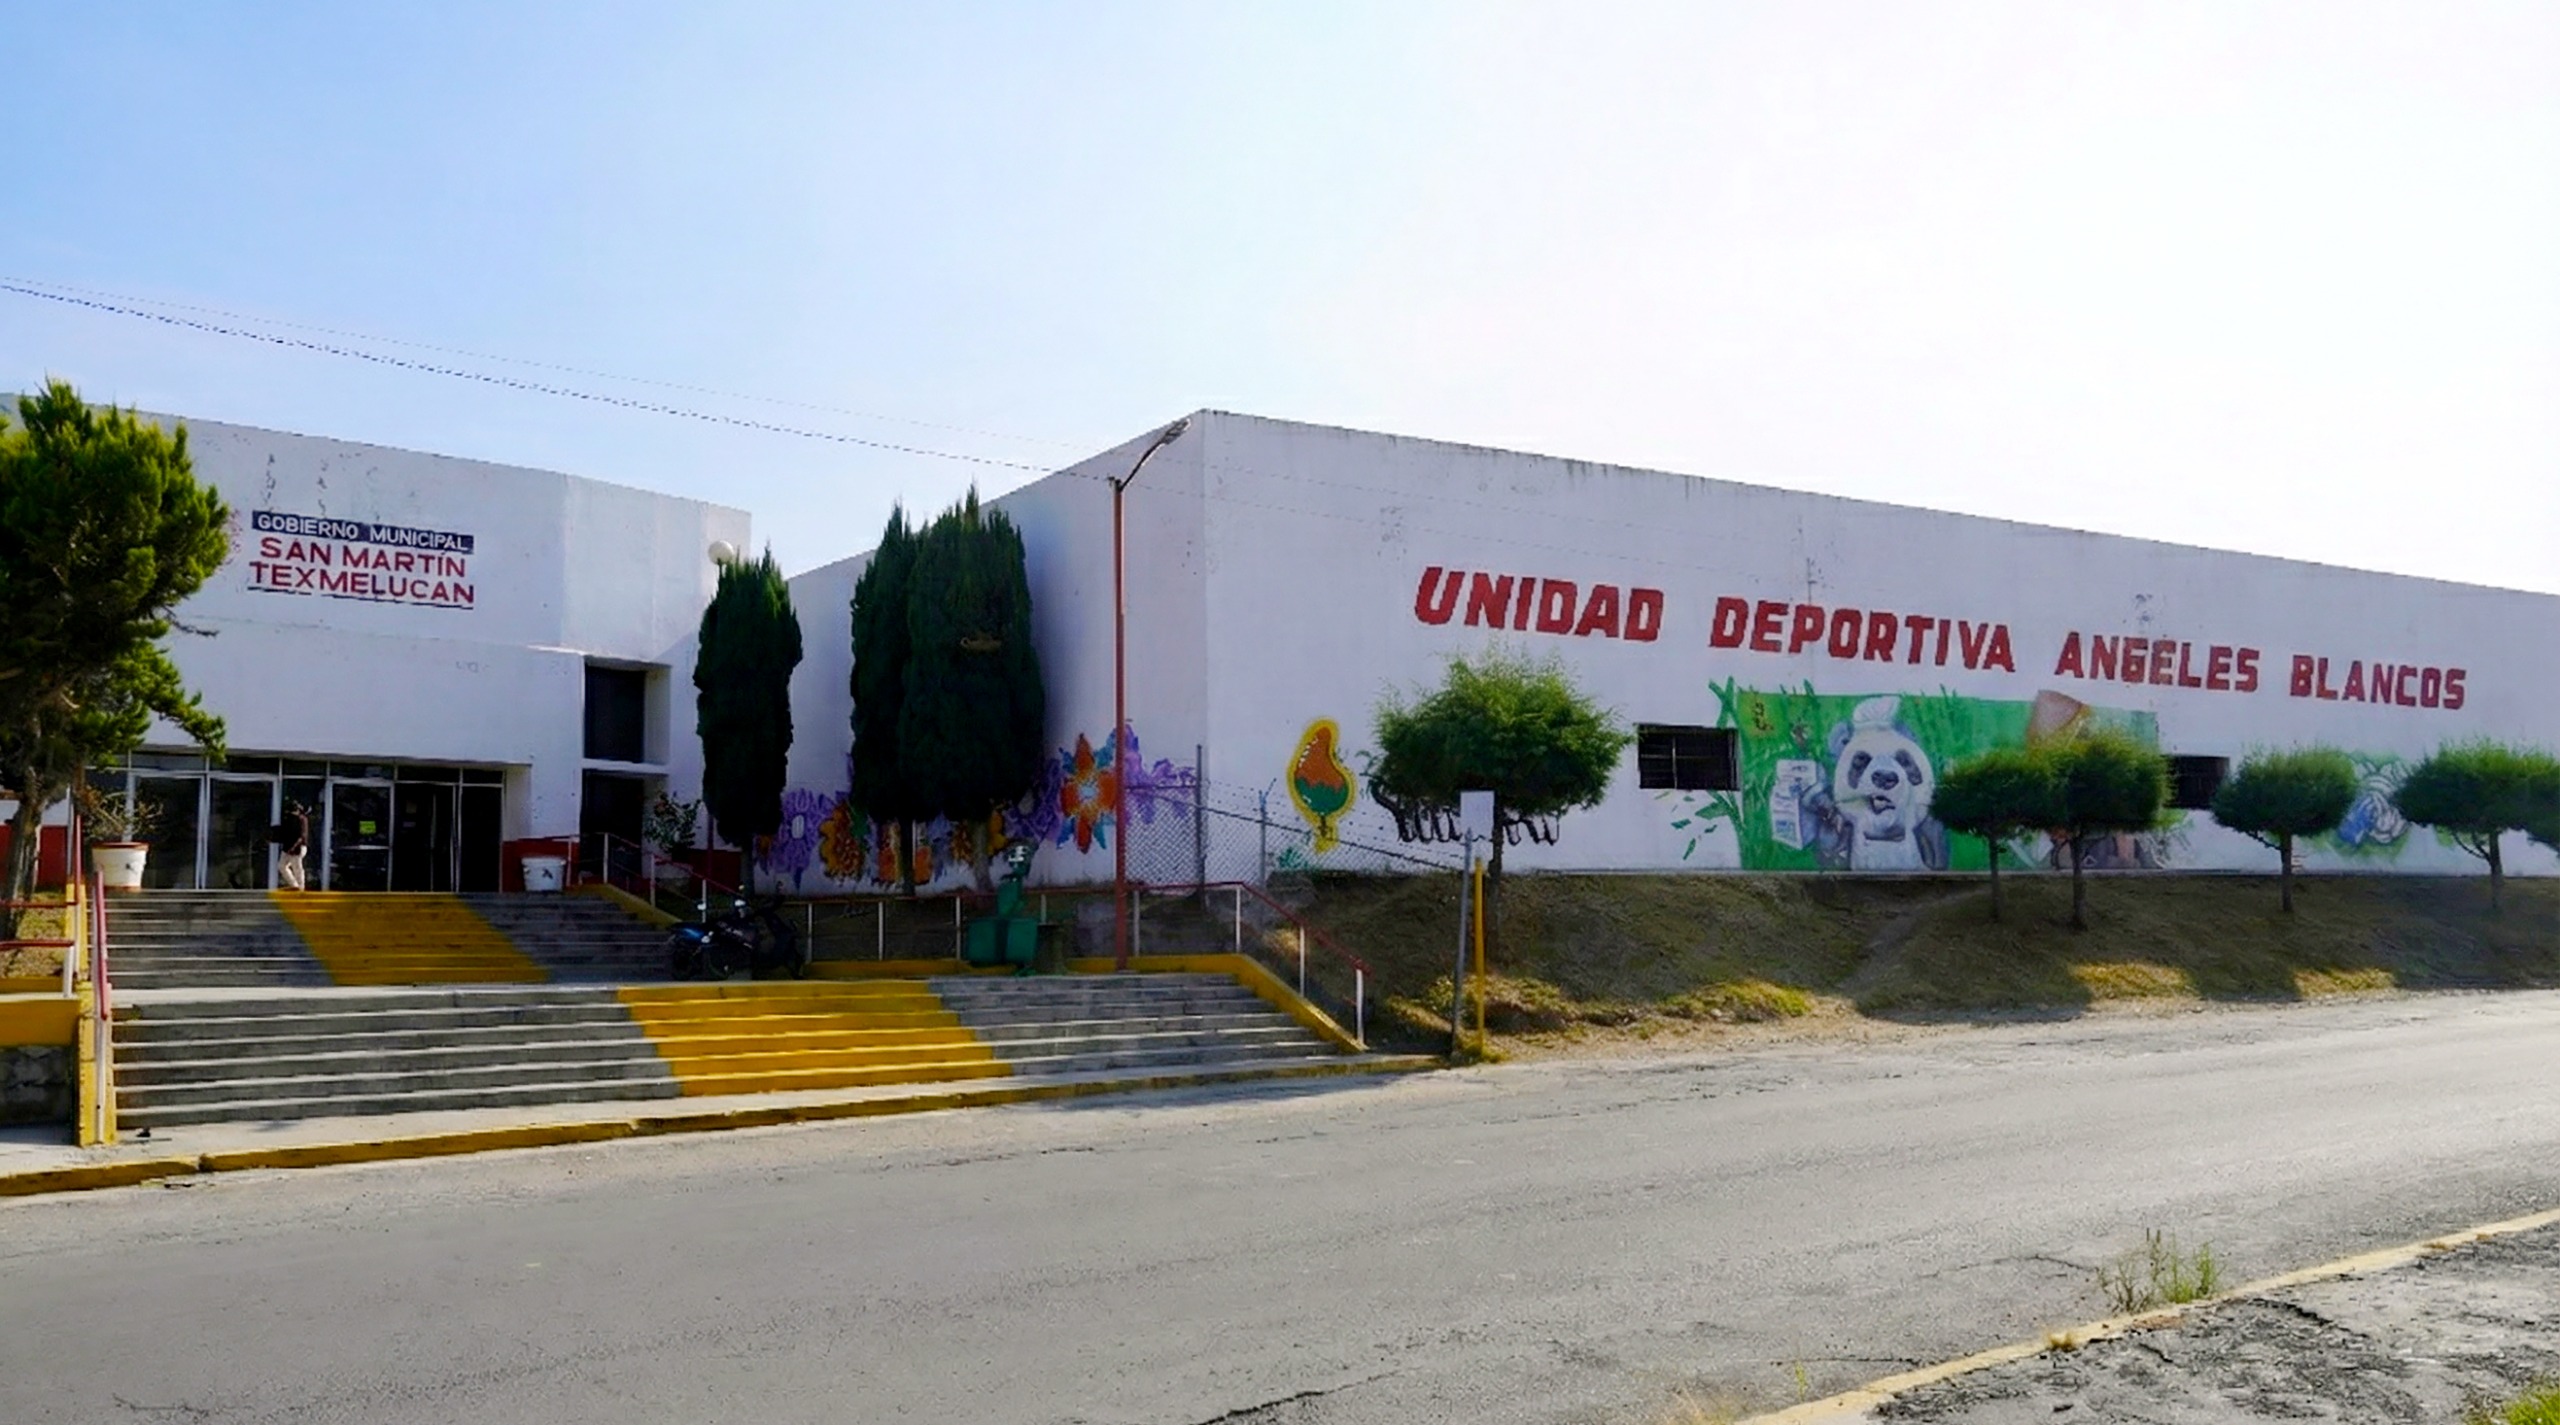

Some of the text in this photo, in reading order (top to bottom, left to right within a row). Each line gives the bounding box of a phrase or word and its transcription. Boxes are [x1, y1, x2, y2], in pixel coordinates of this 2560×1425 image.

[257, 513, 469, 551] GOBIERNO MUNICIPAL
[259, 537, 331, 566] SAN
[249, 561, 474, 604] TEXMELUCAN
[1414, 566, 2468, 710] UNIDAD DEPORTIVA ANGELES BLANCOS
